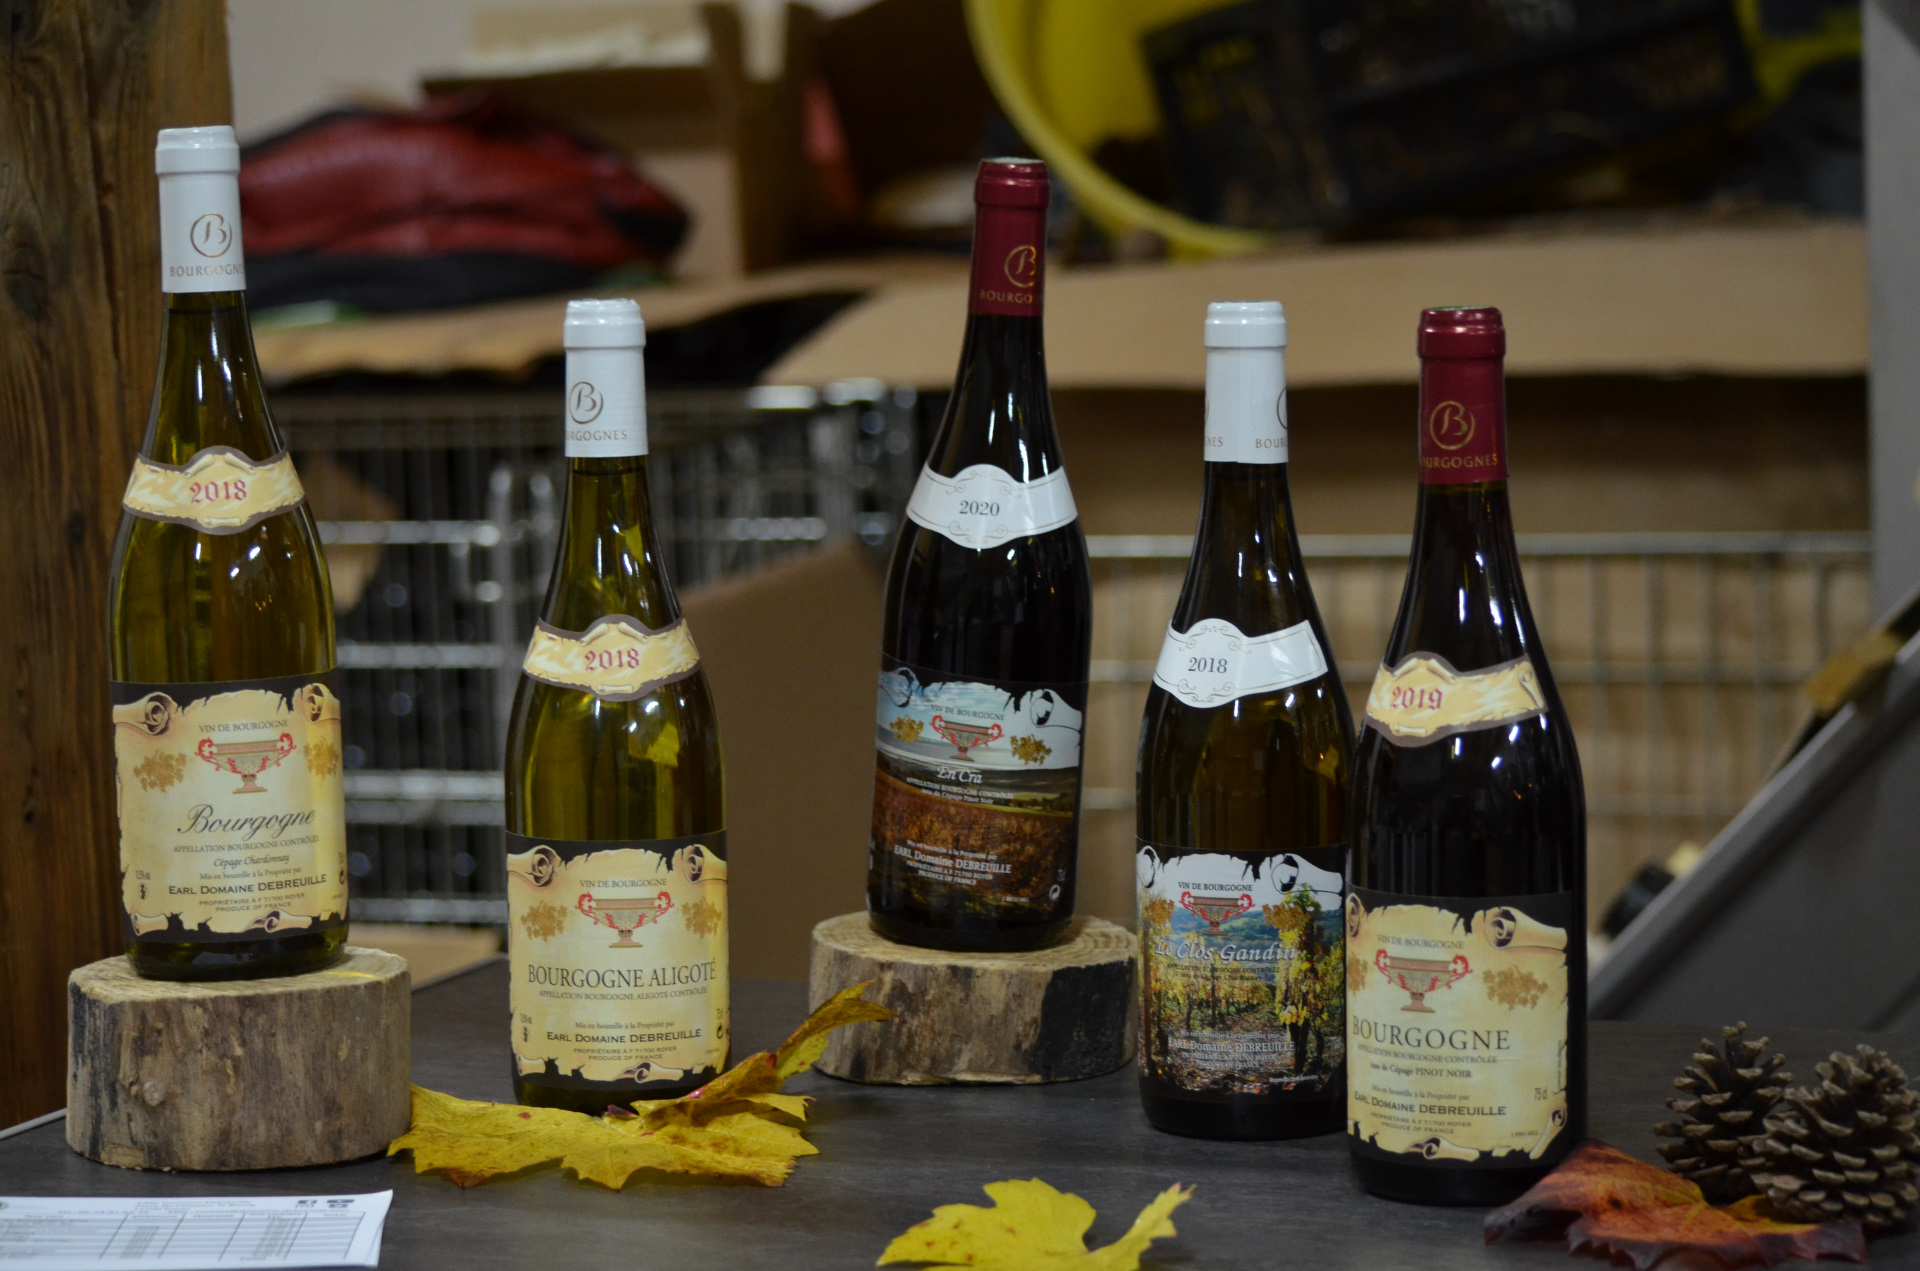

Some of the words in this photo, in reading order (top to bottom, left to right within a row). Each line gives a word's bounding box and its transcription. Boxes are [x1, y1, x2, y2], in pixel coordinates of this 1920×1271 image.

[190, 479, 247, 504] 2018
[959, 501, 1000, 517] 2020
[584, 648, 640, 671] 2018
[1188, 657, 1227, 674] 2018
[1390, 687, 1443, 710] 2019
[931, 704, 943, 712] VIN
[945, 706, 955, 714] DE
[957, 709, 1005, 721] BOURGOGNE
[233, 720, 289, 731] BOURGOGNE
[937, 766, 956, 780] En
[958, 770, 983, 784] Cra
[177, 804, 315, 841] Bourgogne
[173, 844, 225, 853] APPELLATION
[227, 841, 279, 852] BOURGOGNE
[213, 857, 243, 869] Cépage
[245, 855, 290, 866] Chardonnay
[894, 844, 913, 858] EARL
[914, 850, 953, 867] Domaine
[955, 859, 1013, 874] DEBREUILLE
[224, 871, 251, 880] bouteille
[265, 868, 292, 877] Propriété
[168, 886, 197, 895] EARL
[200, 884, 254, 894] DOMAINE
[258, 874, 327, 892] DEBREUILLE
[612, 878, 668, 888] BOURGOGNE
[1178, 881, 1189, 889] VIN
[1192, 882, 1201, 890] DE
[1203, 884, 1253, 892] BOURGOGNE
[199, 898, 249, 906] PROPRIÉTAIRE
[216, 904, 249, 912] PRODUCE
[264, 901, 292, 909] FRANCE
[1378, 935, 1390, 943] VIN
[1392, 936, 1402, 945] DE
[1405, 938, 1464, 949] BOURGOGNE
[1176, 941, 1213, 961] Clos
[1220, 942, 1296, 965] Gandin
[528, 964, 644, 988] BOURGOGNE
[648, 957, 717, 987] ALIGOTÉ
[540, 991, 582, 1000] APPELLATION
[585, 992, 635, 1001] BOURGOGNE
[547, 1031, 572, 1042] EARL
[575, 1034, 626, 1043] DOMAINE
[630, 1029, 702, 1043] DEBREUILLE
[1353, 1016, 1510, 1050] BOURGOGNE
[1190, 1040, 1232, 1053] Domaine
[1235, 1042, 1295, 1053] DEBREUILLE
[1357, 1043, 1391, 1056] APPELLATION
[1393, 1049, 1443, 1062] BOURGOGNE
[1445, 1055, 1497, 1063] CONTRÔLÉE
[1415, 1067, 1444, 1077] PINOT
[1446, 1069, 1472, 1078] NOIR
[1354, 1090, 1369, 1104] EARL
[1372, 1096, 1415, 1113] DOMAINE
[1419, 1104, 1507, 1116] DEBREUILLE
[1427, 1092, 1457, 1101] Propriété
[1370, 1112, 1409, 1124] PROPRIÉTAIRE
[1382, 1121, 1411, 1131] PRODUCE
